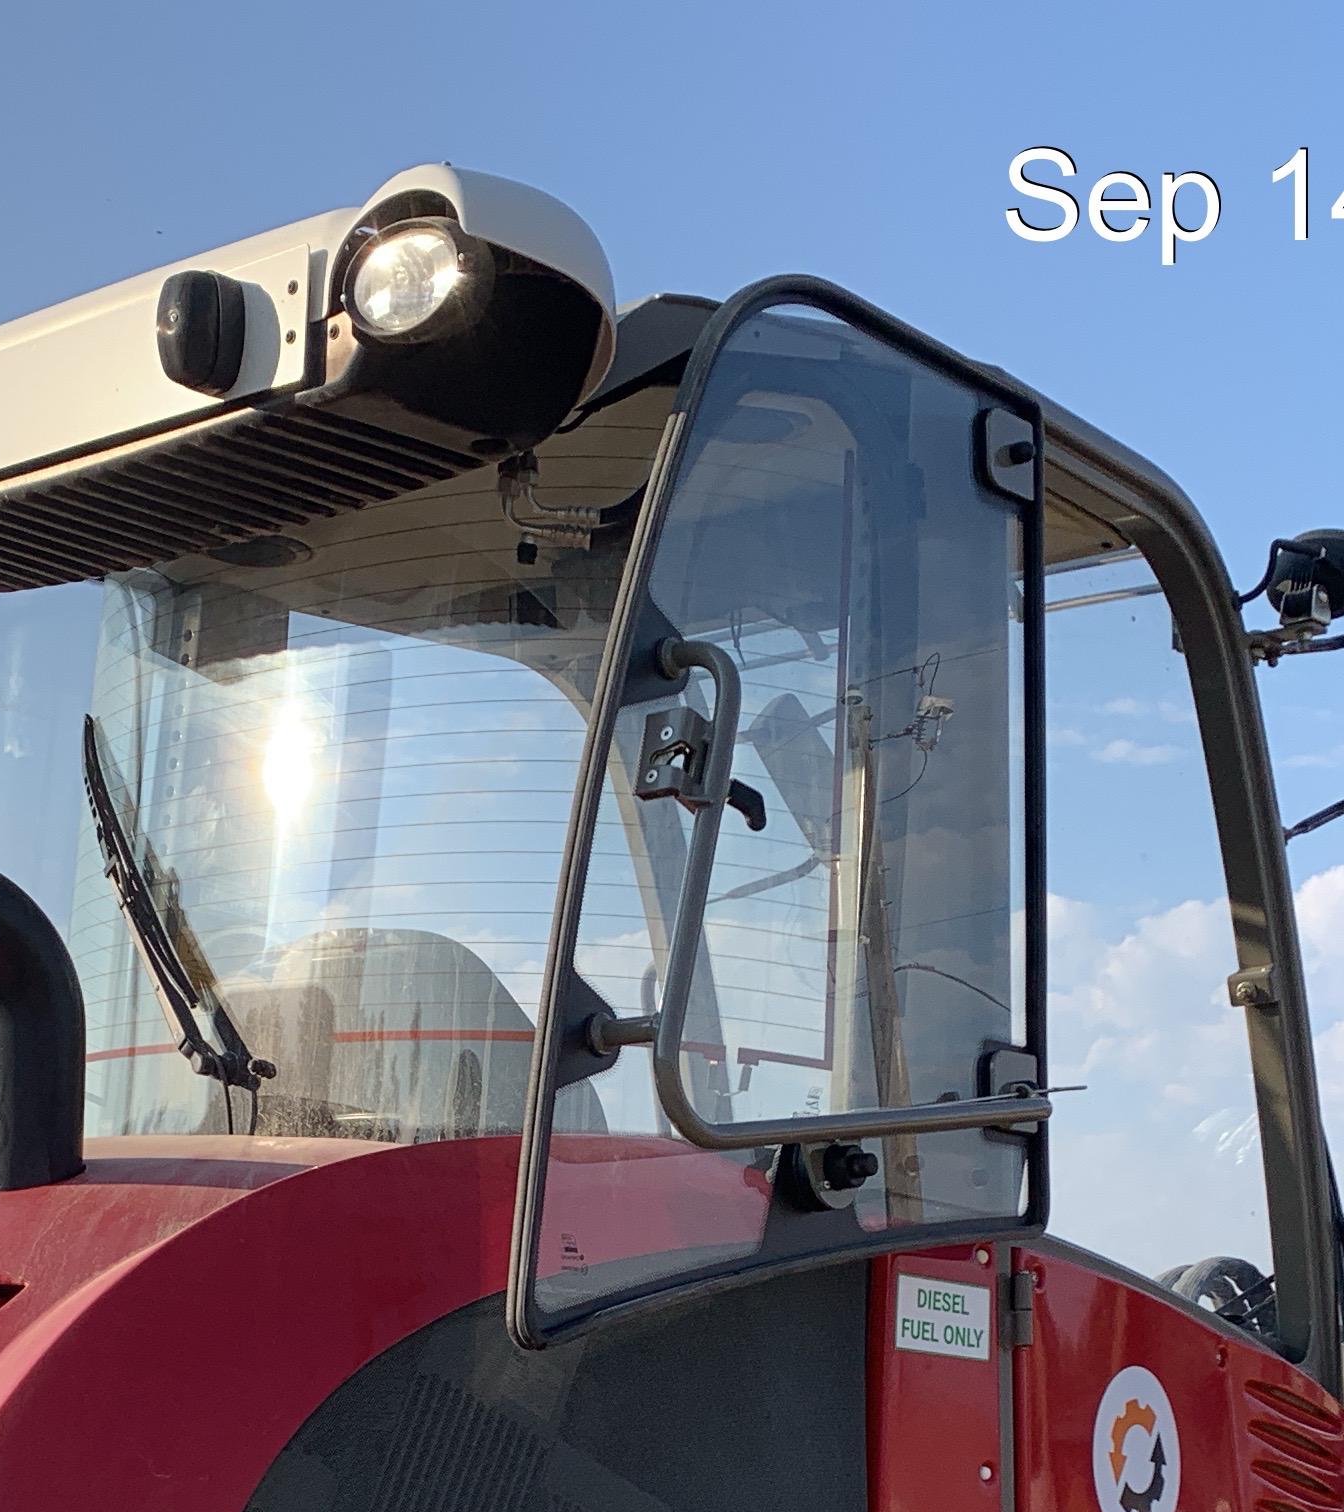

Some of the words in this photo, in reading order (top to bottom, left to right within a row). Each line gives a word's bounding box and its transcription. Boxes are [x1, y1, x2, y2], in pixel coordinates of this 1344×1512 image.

[917, 1288, 970, 1316] DIESEL
[901, 1317, 939, 1343] FUEL
[943, 1324, 984, 1349] ONLY
